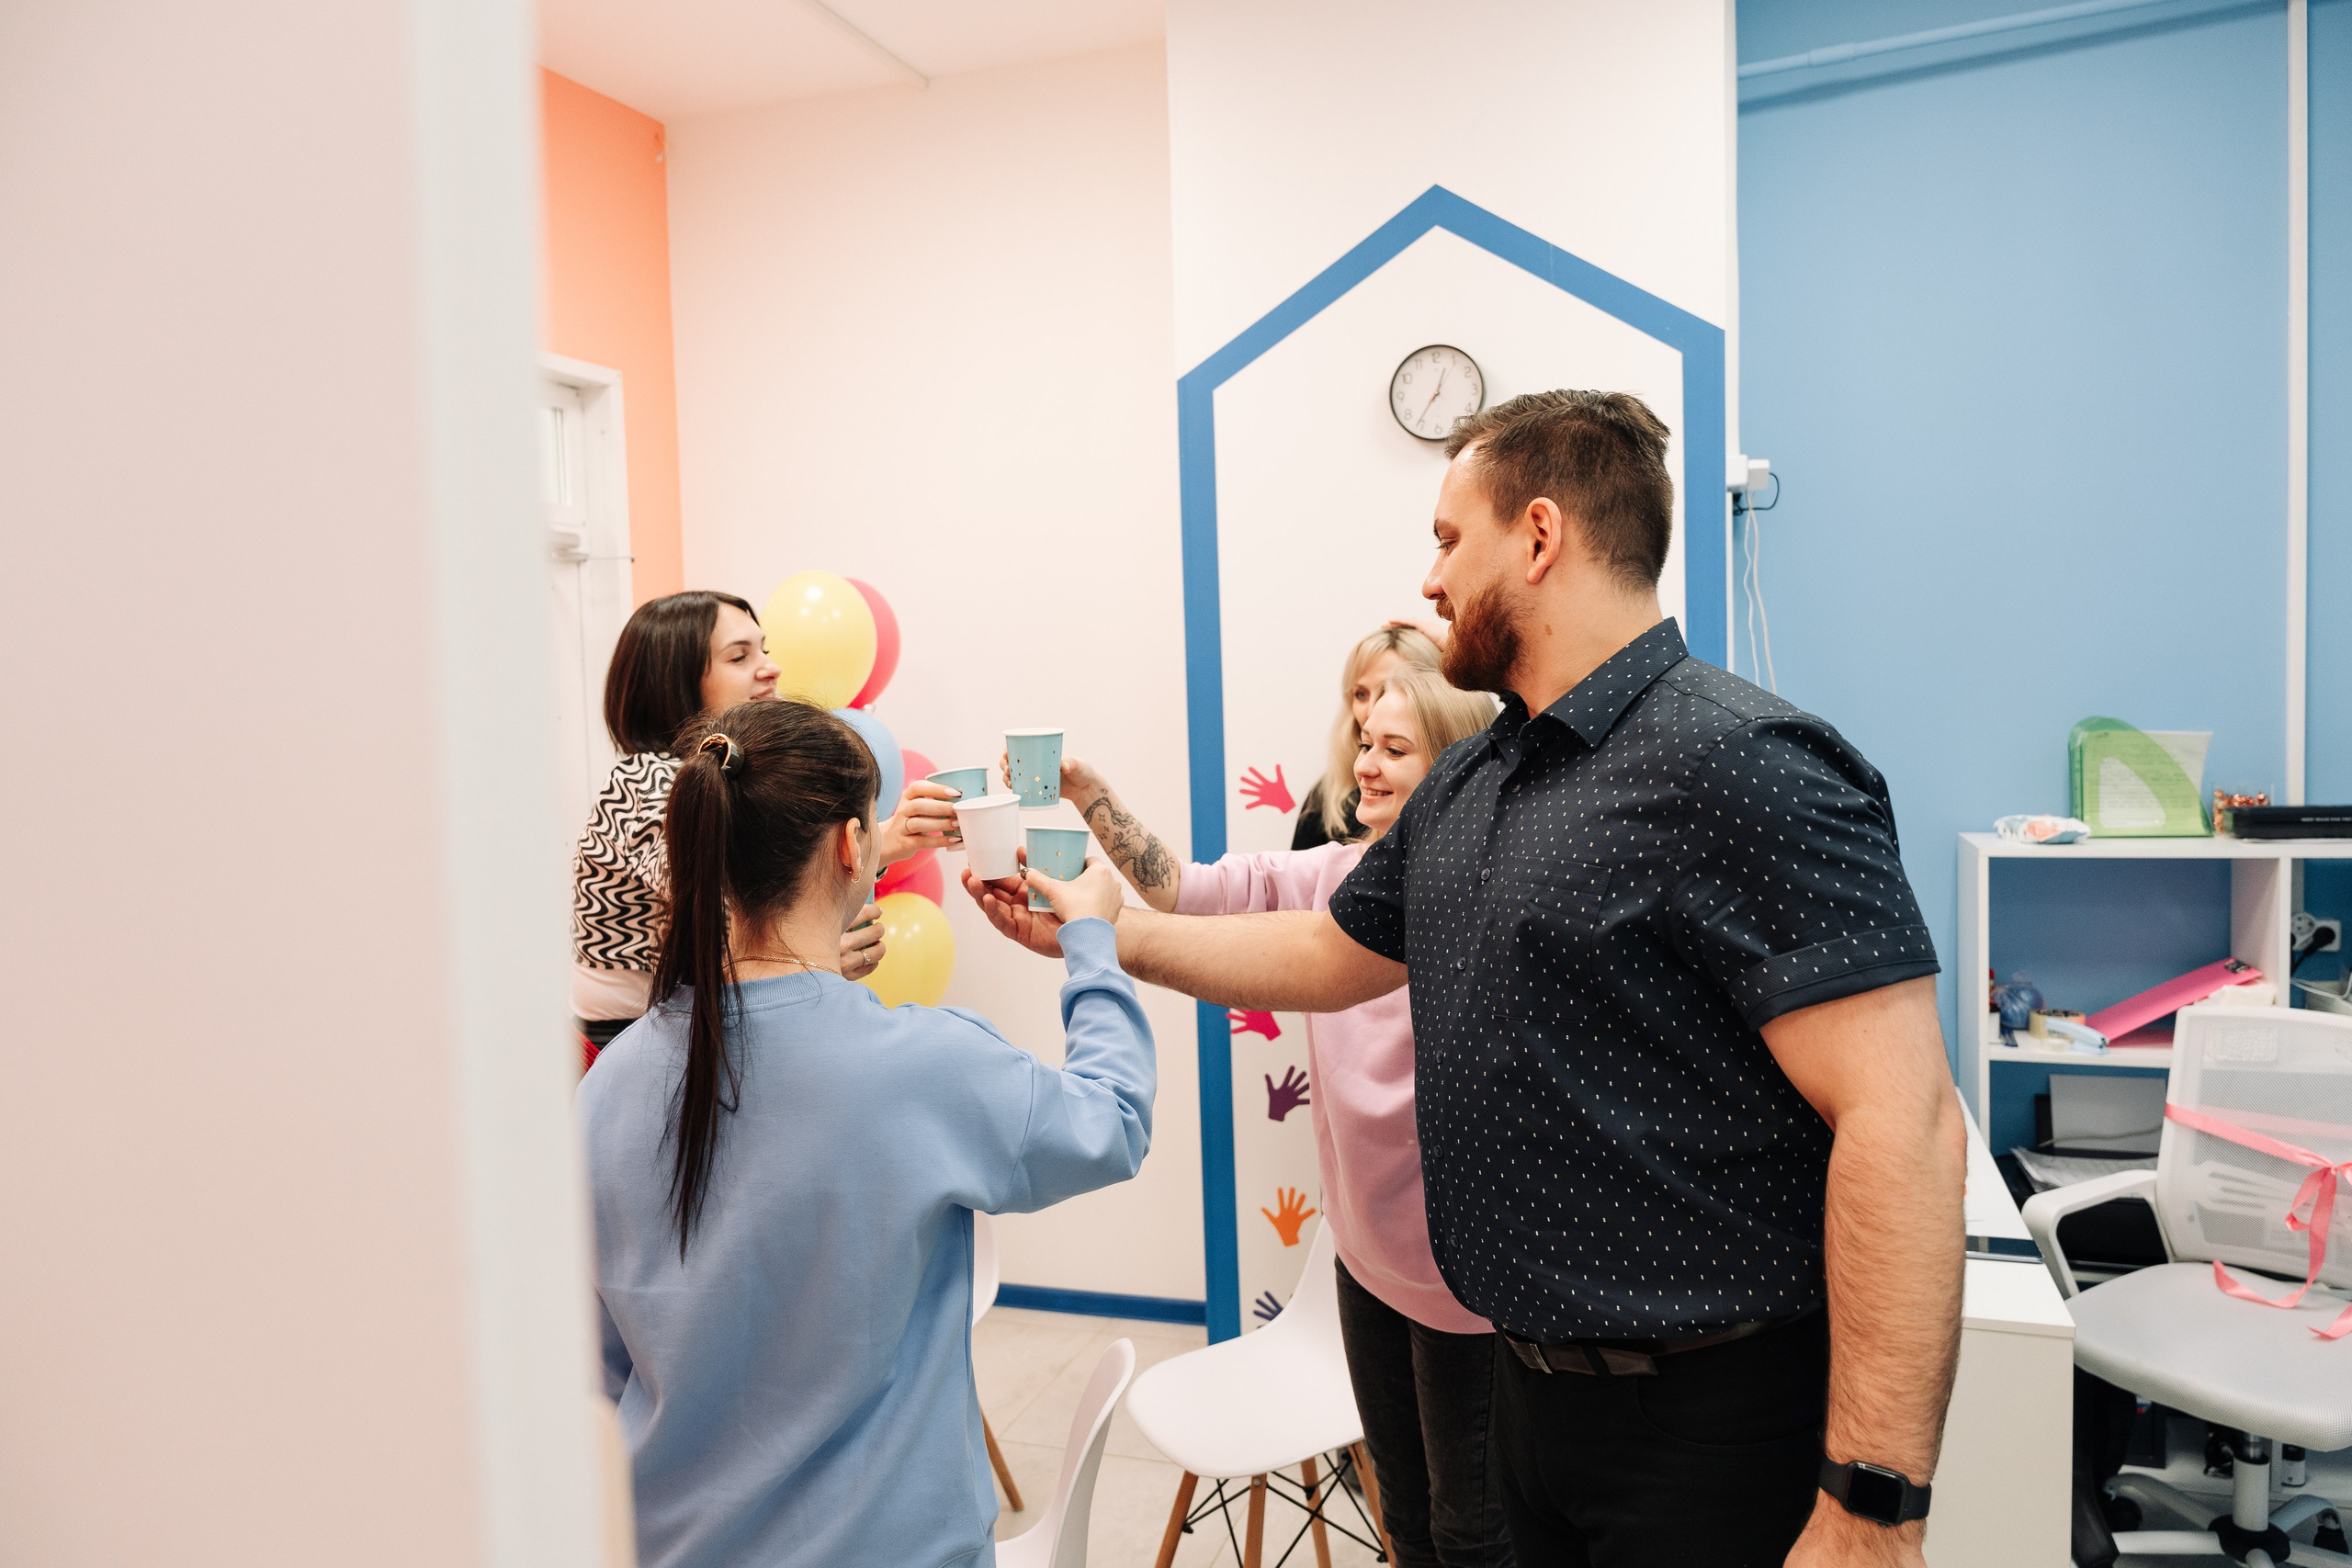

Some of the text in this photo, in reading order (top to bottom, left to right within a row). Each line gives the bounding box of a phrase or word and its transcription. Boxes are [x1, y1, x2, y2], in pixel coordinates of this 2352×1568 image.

[1463, 366, 1472, 378] 2
[1471, 383, 1478, 396] 3
[1396, 391, 1405, 402] 9
[1403, 409, 1412, 421] 8
[1433, 423, 1443, 435] 6
